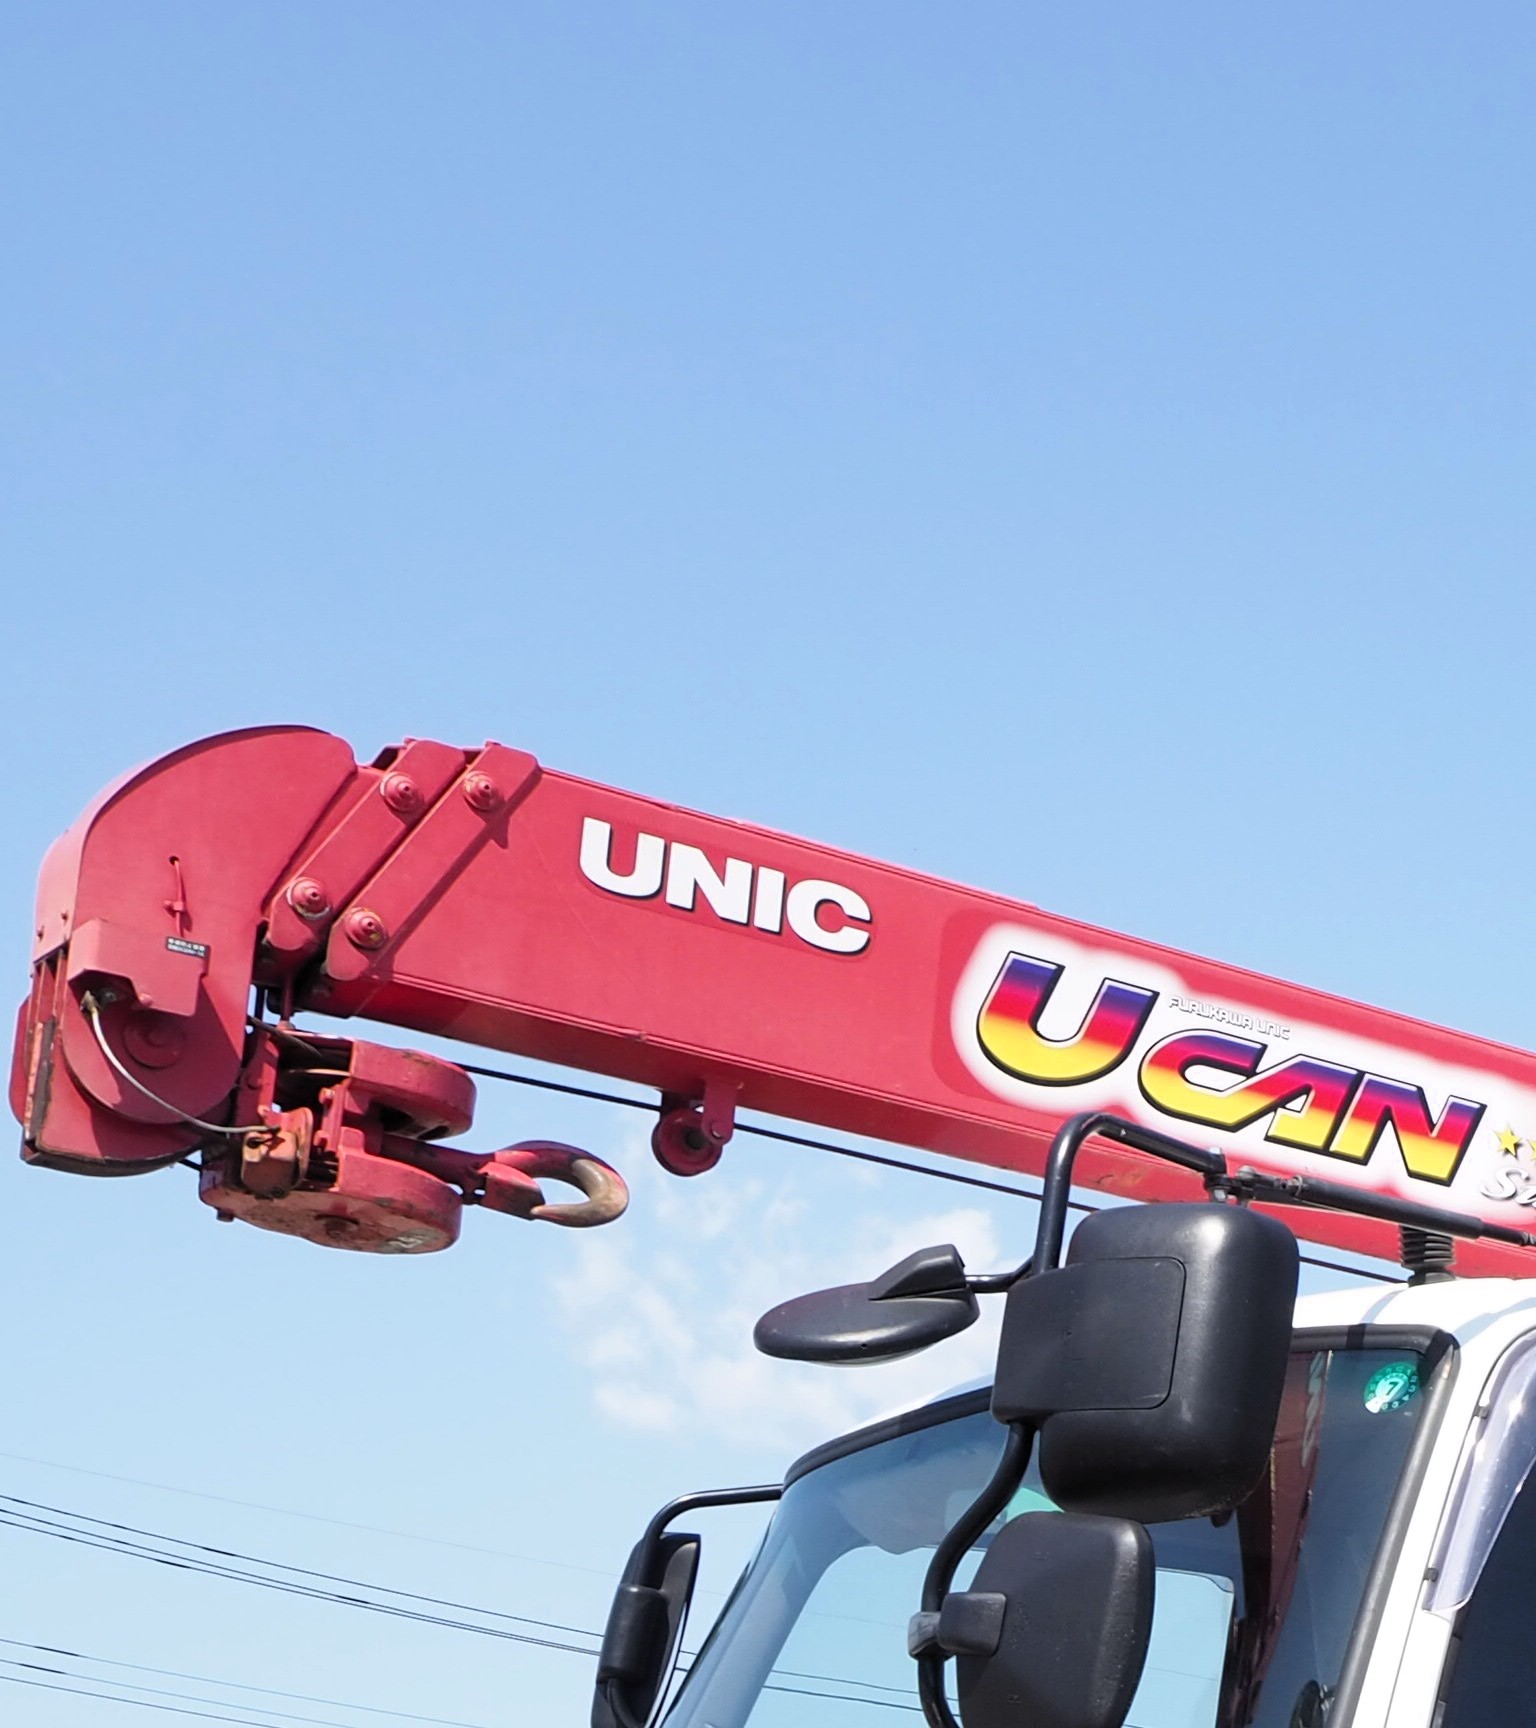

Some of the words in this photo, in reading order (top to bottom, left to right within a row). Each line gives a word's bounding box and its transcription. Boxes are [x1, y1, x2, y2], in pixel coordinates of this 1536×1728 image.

[579, 816, 872, 956] UNIC
[976, 950, 1488, 1187] UCAN
[1168, 996, 1254, 1031] FURUKAWA
[1254, 1017, 1291, 1041] UNIC
